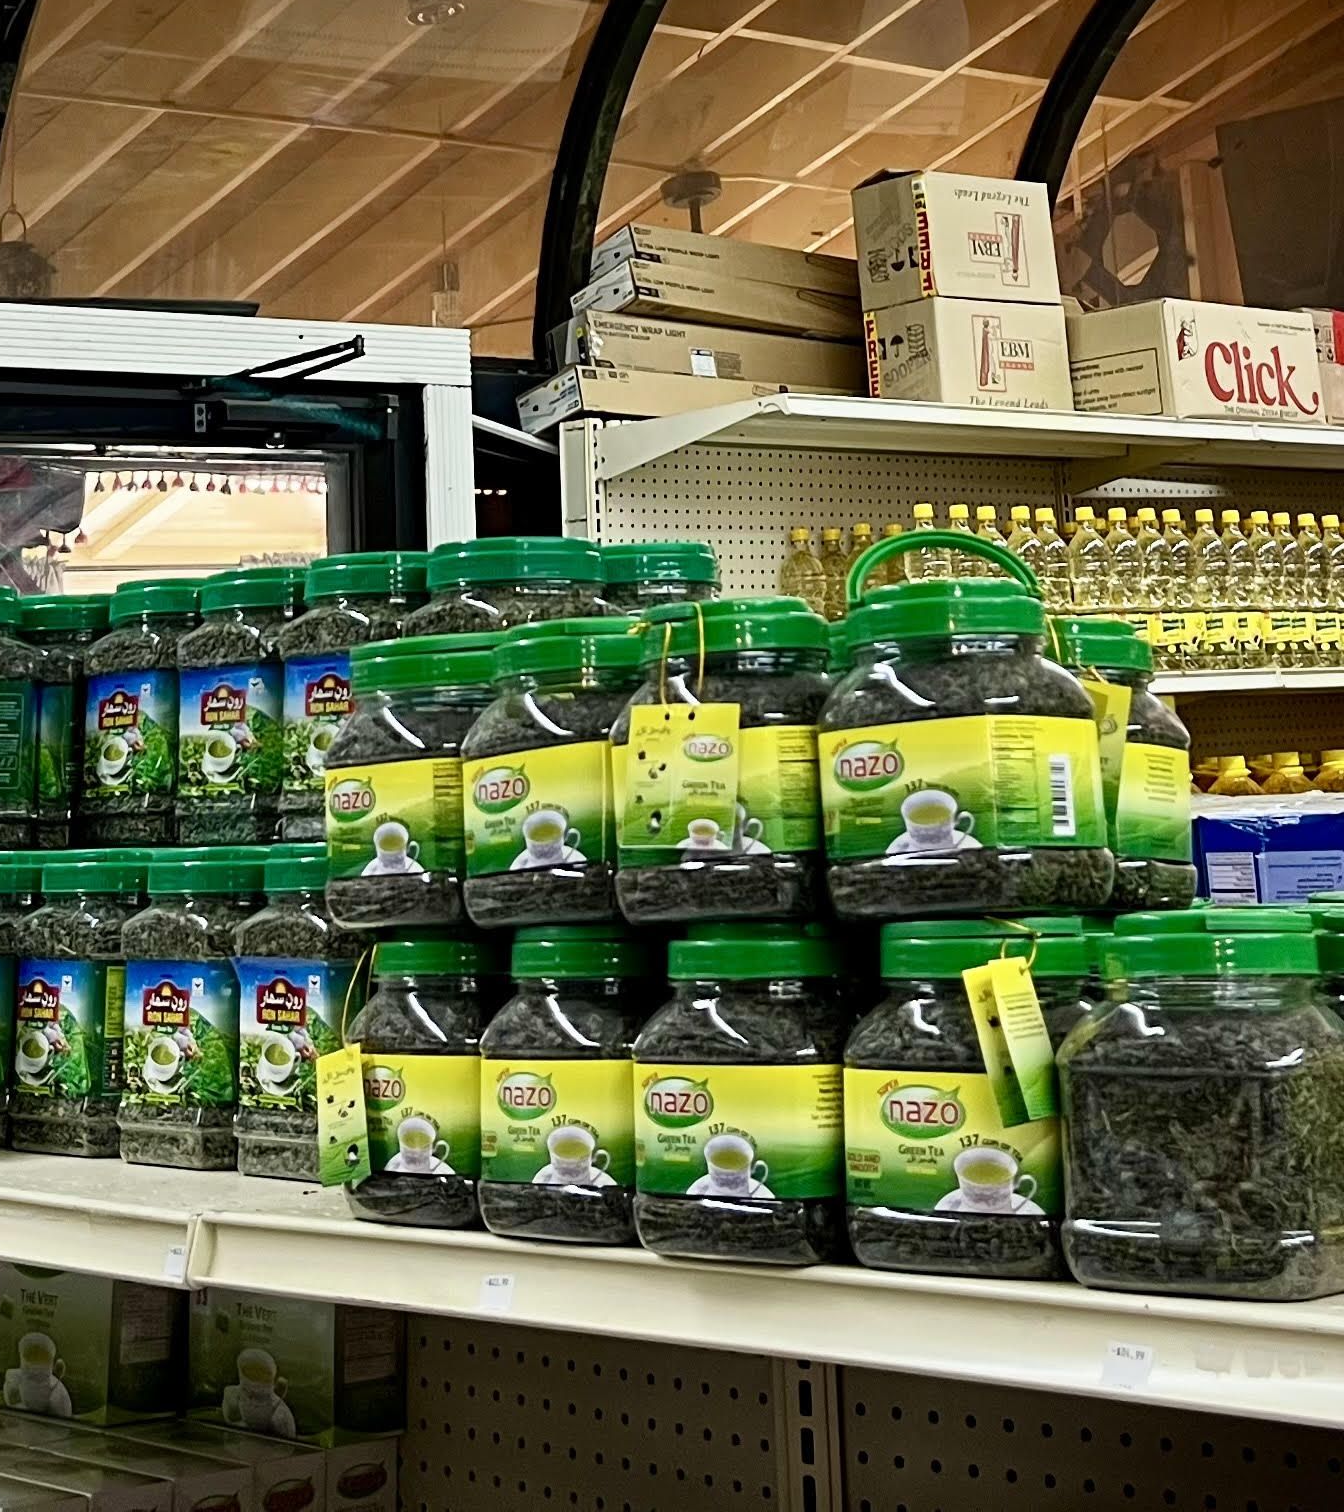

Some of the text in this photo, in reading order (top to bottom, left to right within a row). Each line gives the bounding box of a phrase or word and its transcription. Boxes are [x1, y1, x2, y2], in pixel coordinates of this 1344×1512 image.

[954, 189, 1030, 207] The Legend Leads
[918, 211, 934, 291] FREE
[972, 239, 1002, 258] EBM
[642, 325, 663, 336] WRAP
[665, 327, 686, 338] LIGHT
[865, 319, 880, 398] FREE
[1000, 340, 1030, 358] EBM
[1204, 341, 1319, 416] Click
[970, 396, 986, 405] The
[687, 739, 730, 756] nazo
[838, 750, 899, 780] nazo
[475, 776, 527, 802] nazo
[332, 791, 373, 812] nazo
[503, 1087, 551, 1106] nazo
[650, 1092, 708, 1114] nazo
[890, 1100, 959, 1124] nazo
[682, 1134, 696, 1144] TEA
[960, 1134, 979, 1148] 137
[898, 1144, 944, 1157] GREEN TEA
